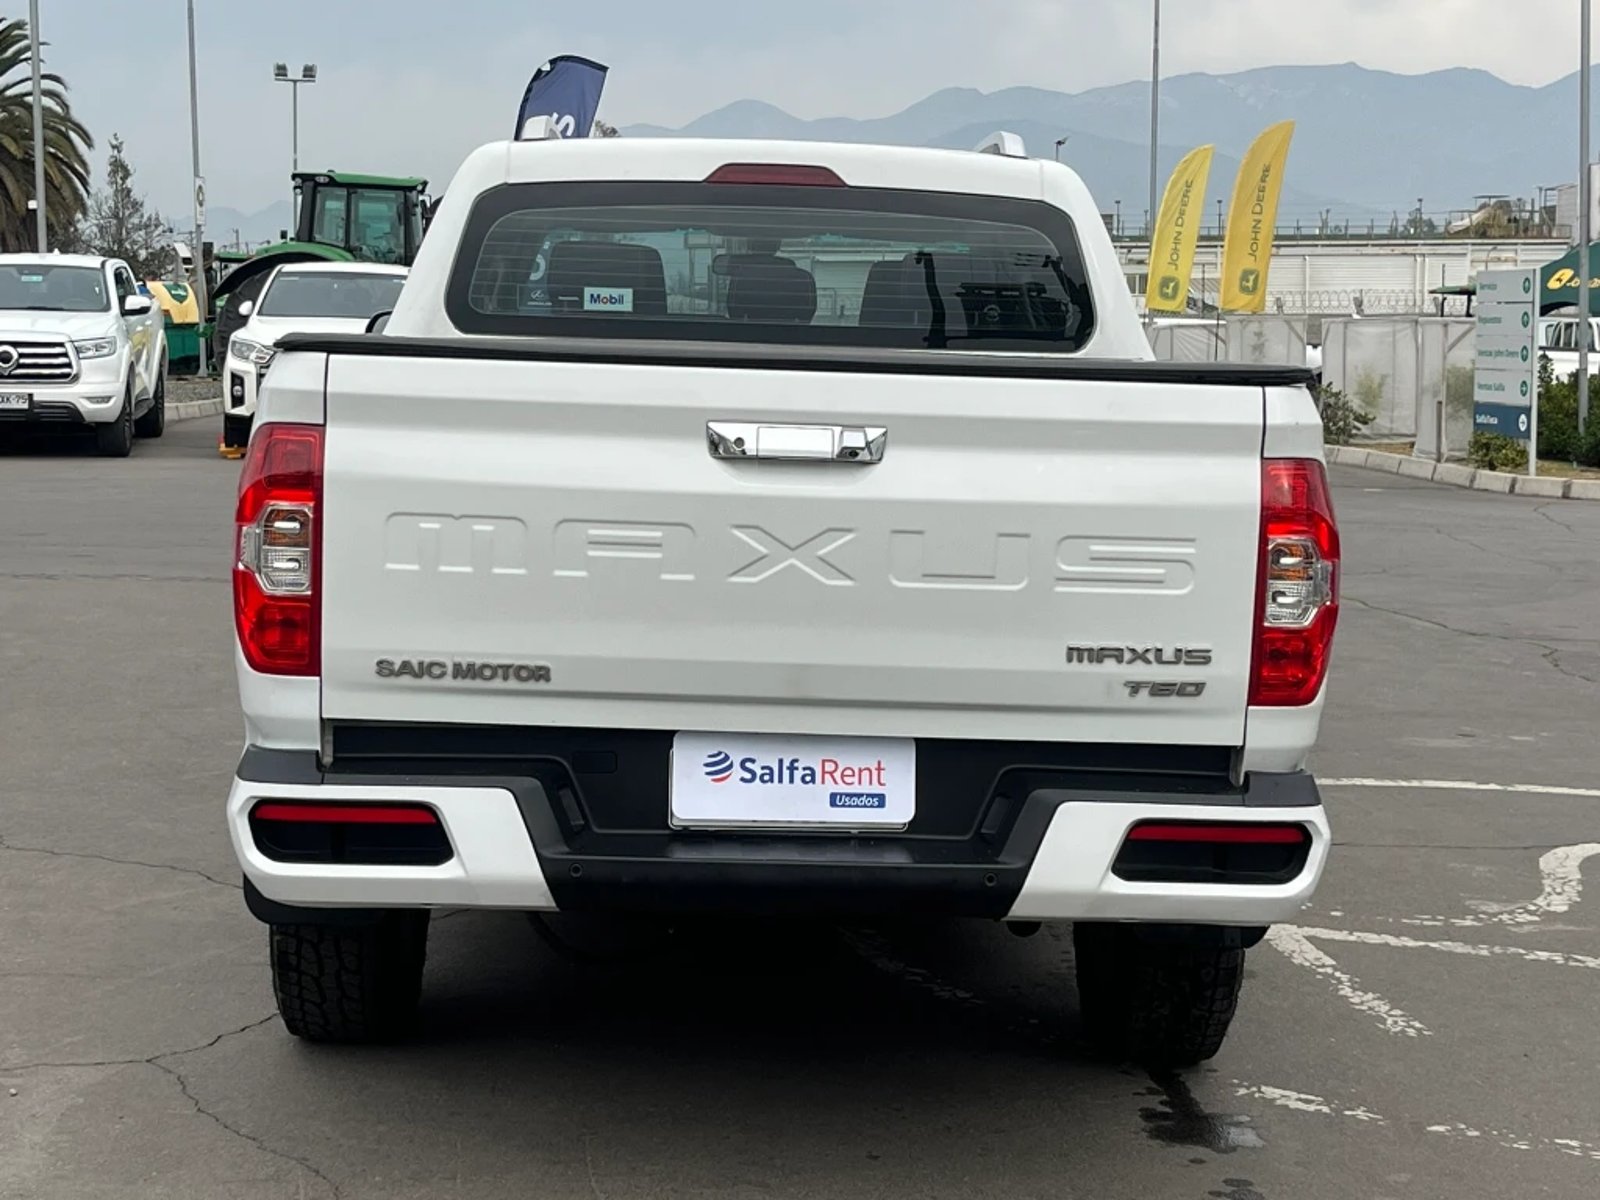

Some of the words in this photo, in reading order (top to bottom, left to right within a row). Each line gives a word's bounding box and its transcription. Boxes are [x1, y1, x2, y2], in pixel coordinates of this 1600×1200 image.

[1252, 163, 1272, 215] DEERE
[1167, 230, 1183, 271] JOHN
[1175, 179, 1194, 228] DEERE
[1248, 220, 1262, 263] JOHN
[590, 293, 624, 305] Mobil
[384, 511, 1197, 596] MAXUS
[1065, 643, 1213, 667] MAXUS
[374, 658, 449, 681] SAIC
[451, 660, 552, 684] MOTOR
[1124, 680, 1207, 698] T60
[739, 757, 887, 787] SalfaRent
[835, 794, 879, 807] Usados
